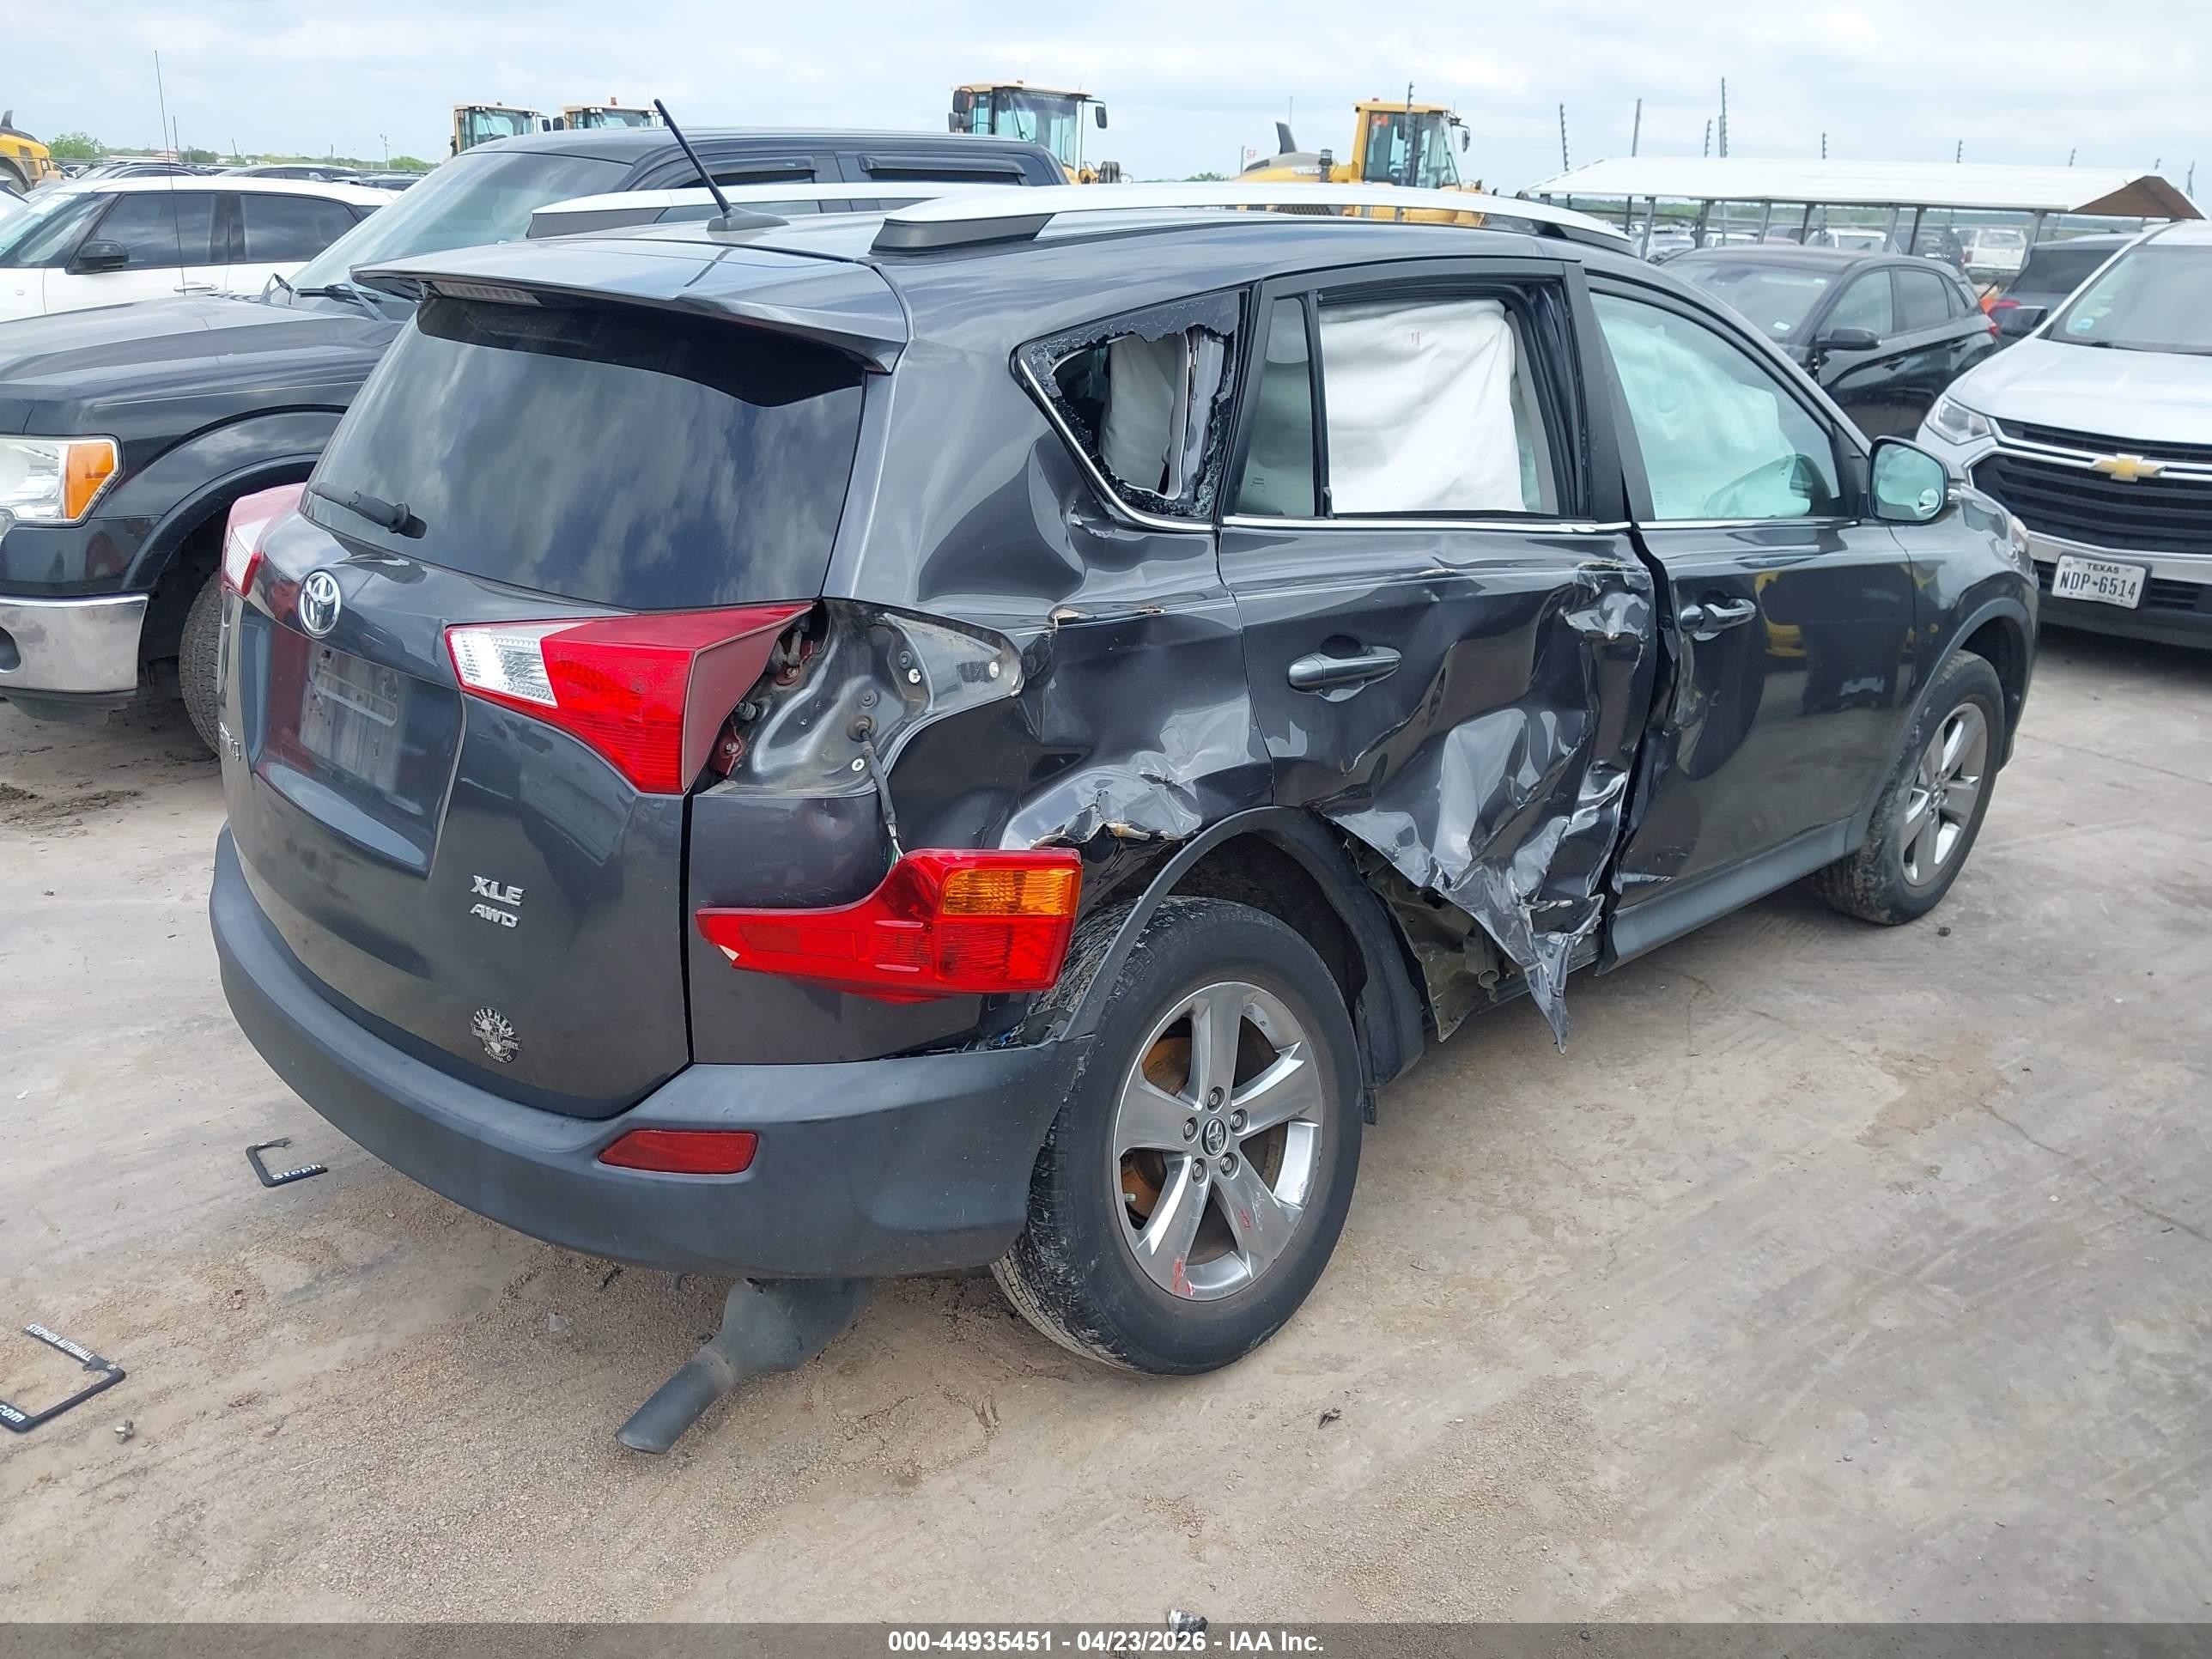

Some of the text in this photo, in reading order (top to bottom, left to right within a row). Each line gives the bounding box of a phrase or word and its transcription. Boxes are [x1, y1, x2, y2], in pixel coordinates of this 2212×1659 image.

[2087, 562, 2119, 574] TEXAS
[470, 874, 525, 907] XLE
[469, 903, 519, 928] AWD
[473, 1007, 515, 1036] STEPHEN
[26, 1323, 94, 1362] STEPHEN AUTOMALL
